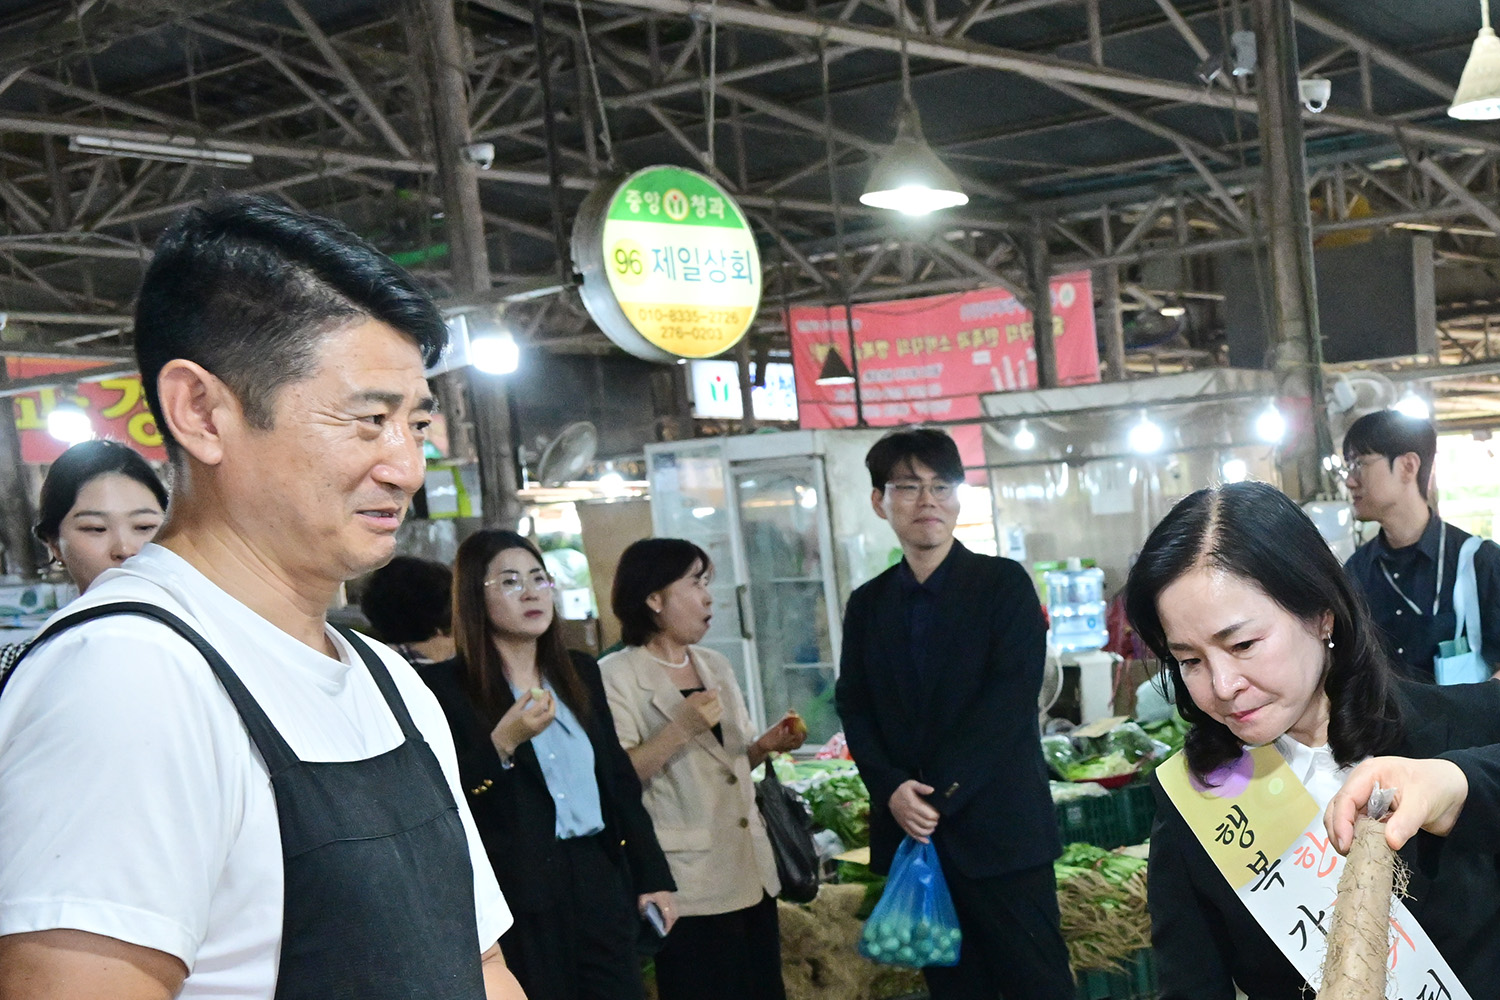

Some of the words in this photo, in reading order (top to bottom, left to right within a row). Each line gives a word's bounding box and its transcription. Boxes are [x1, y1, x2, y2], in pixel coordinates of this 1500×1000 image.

[625, 188, 661, 216] 중앙
[690, 194, 725, 220] 청과
[614, 248, 643, 275] 96
[651, 245, 753, 285] 제일상회
[1214, 803, 1286, 892] 행복
